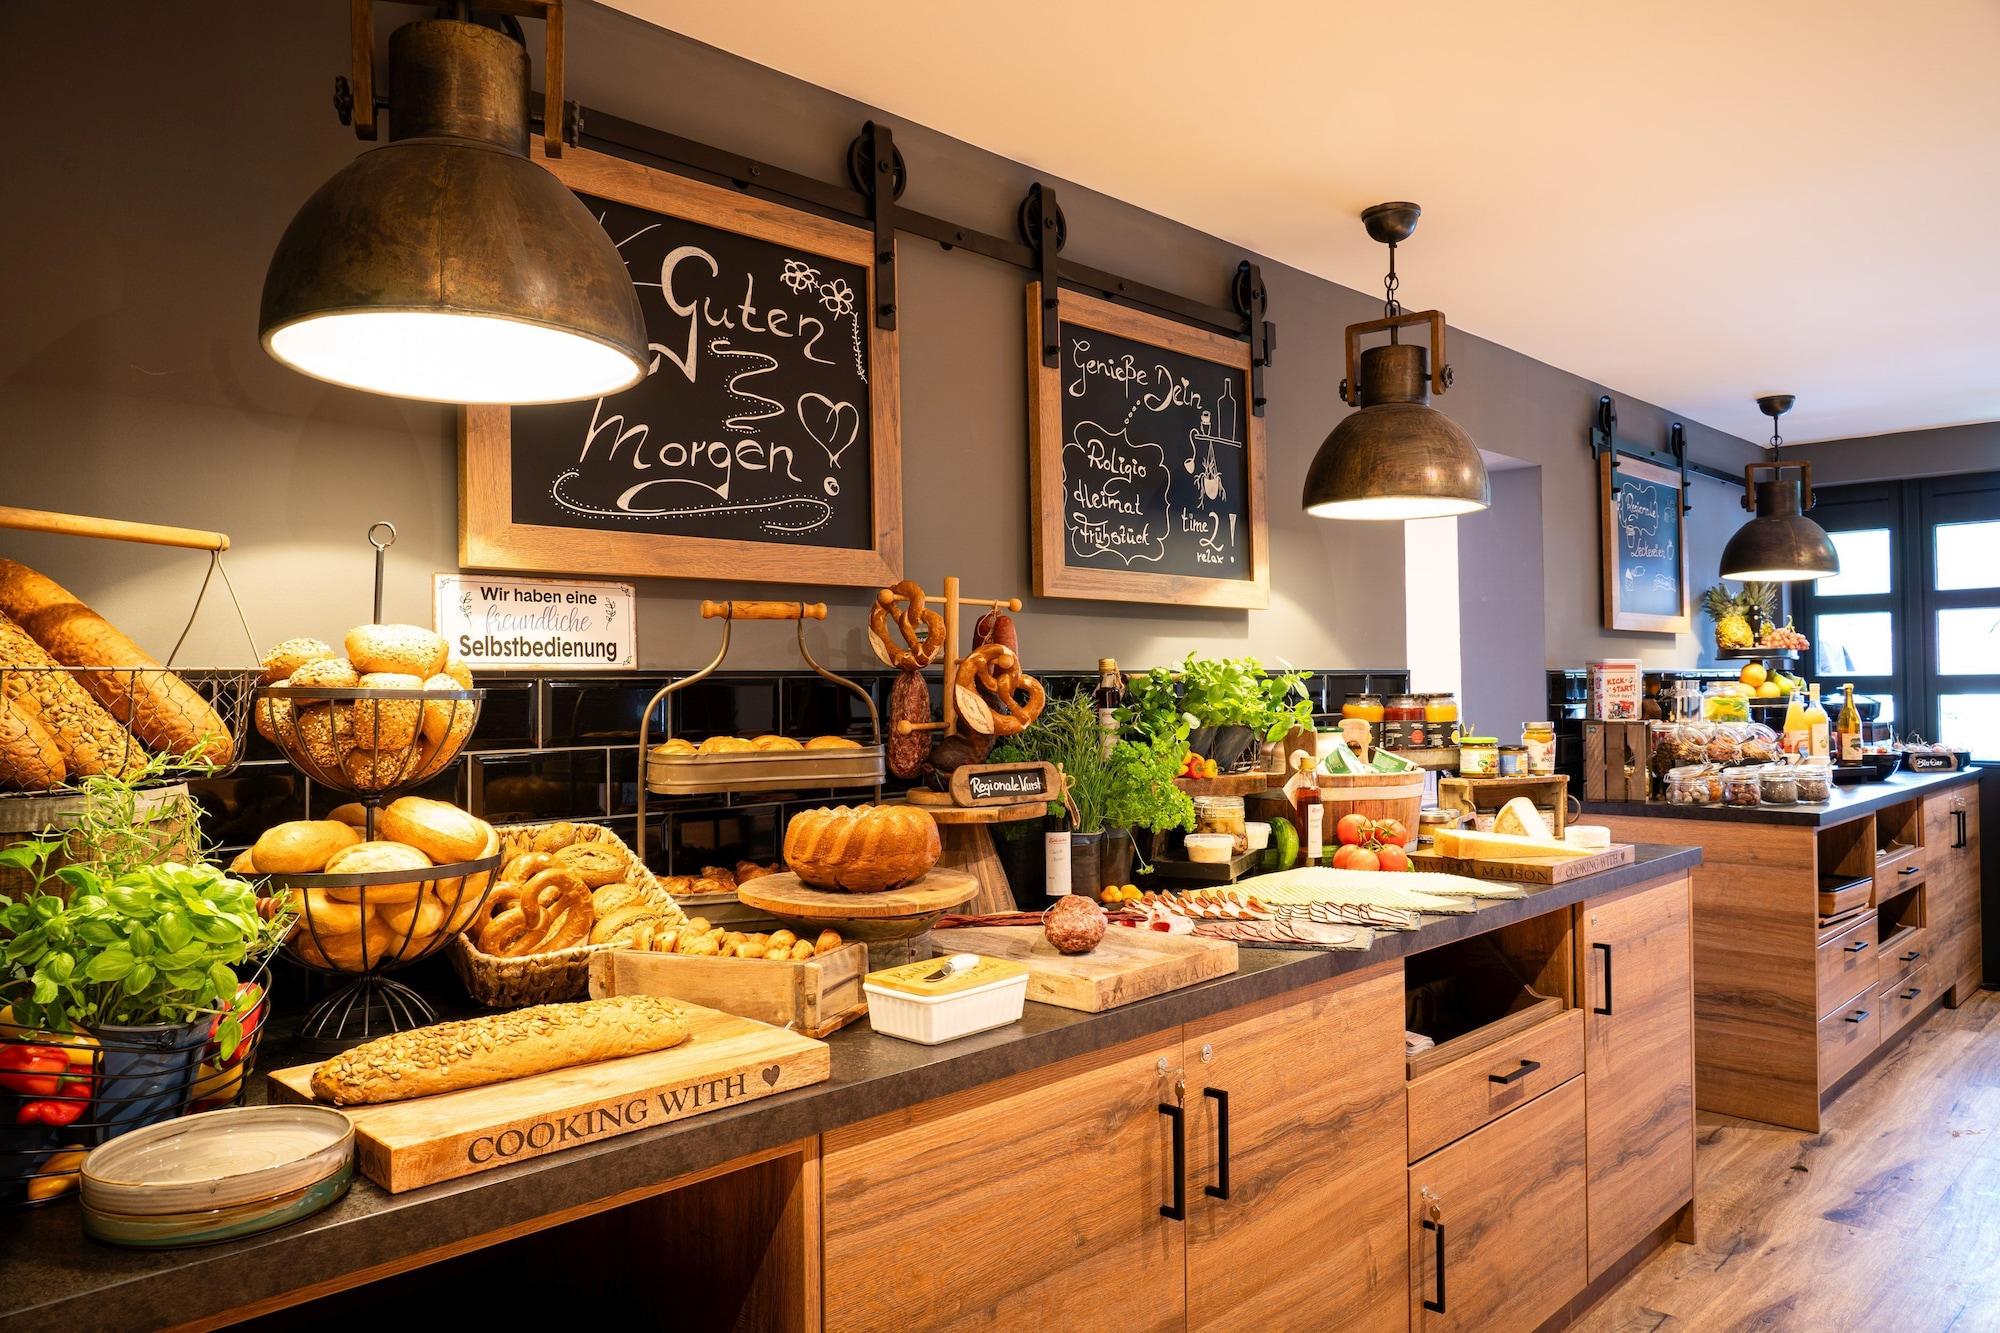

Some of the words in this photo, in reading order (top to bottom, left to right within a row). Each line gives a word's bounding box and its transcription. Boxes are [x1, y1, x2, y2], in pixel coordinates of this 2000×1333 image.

[648, 246, 836, 383] Guten
[1069, 338, 1149, 399] Genieße
[1144, 364, 1203, 412] Dein
[579, 397, 803, 512] Morgen
[1073, 479, 1144, 516] Heimat
[1072, 511, 1150, 550] Frühstück
[1181, 507, 1209, 533] time
[1200, 511, 1224, 551] 2
[480, 586, 510, 602] Wir
[514, 588, 561, 604] haben
[566, 591, 597, 605] eine
[485, 604, 593, 634] freundliche
[459, 634, 617, 662] Selbstbedienung
[1612, 684, 1636, 694] START!
[970, 776, 1020, 798] Regionale
[1018, 775, 1042, 792] Wurst
[1481, 866, 1549, 881] MAISON
[1600, 853, 1619, 869] WITH
[467, 1098, 648, 1165] COOKING
[657, 1072, 748, 1116] WITH
